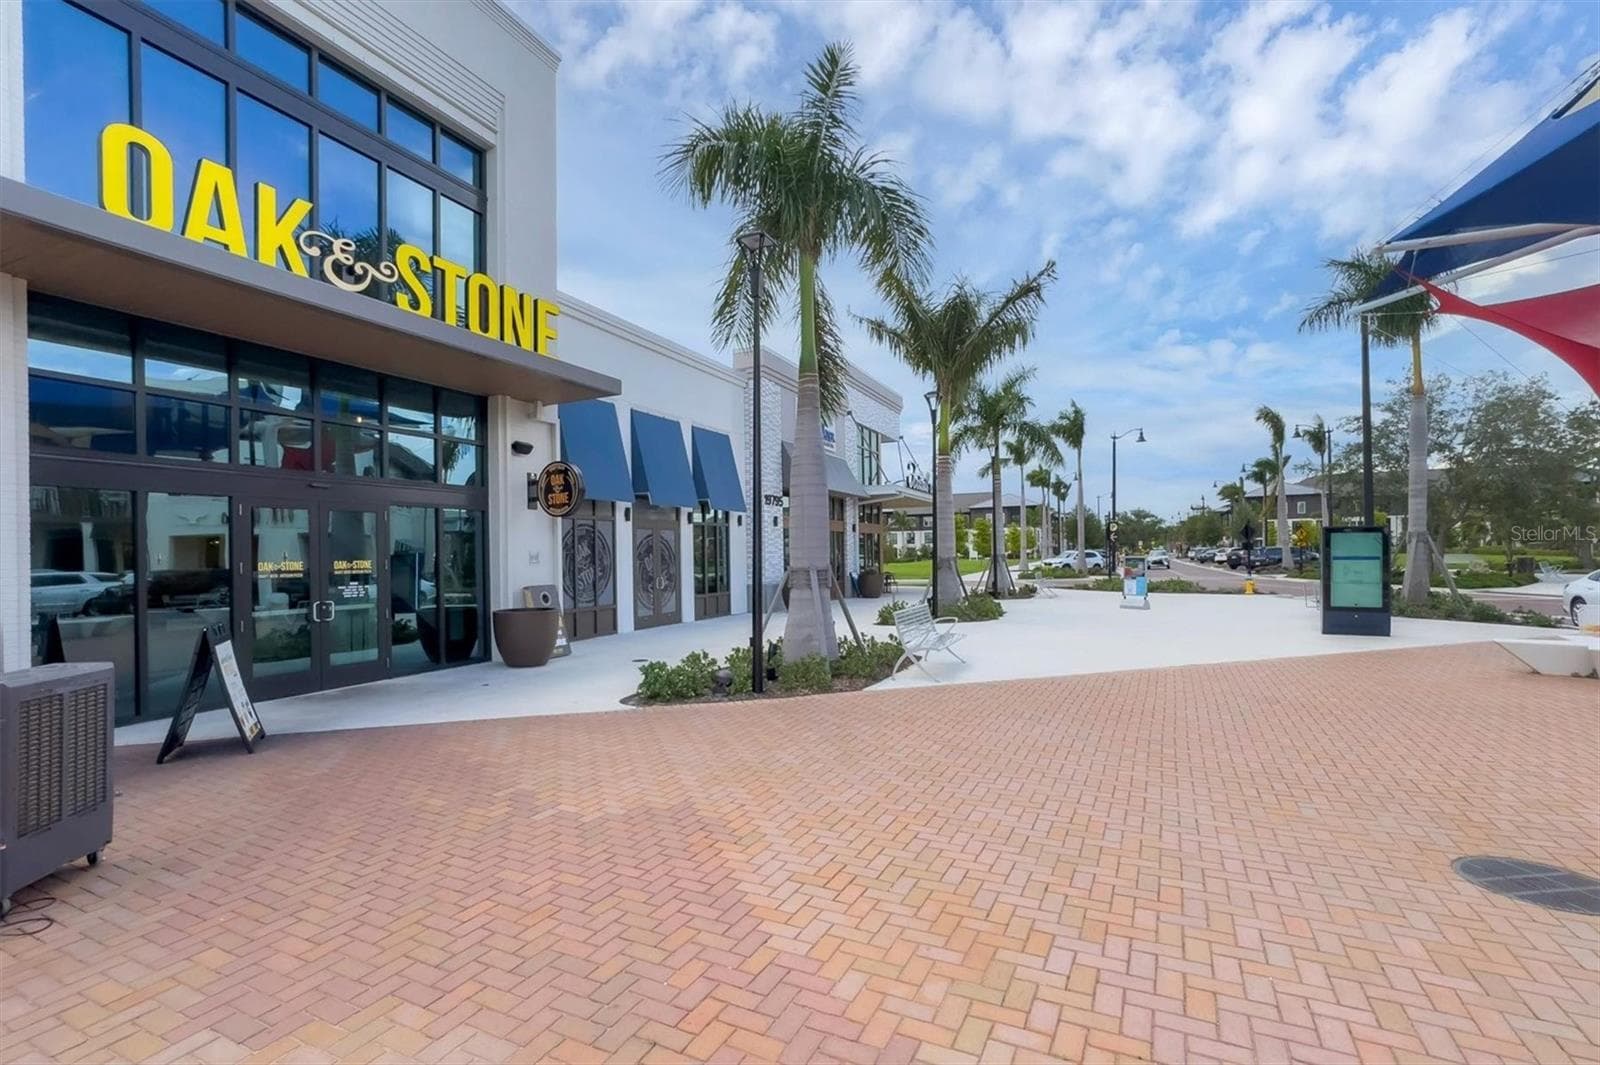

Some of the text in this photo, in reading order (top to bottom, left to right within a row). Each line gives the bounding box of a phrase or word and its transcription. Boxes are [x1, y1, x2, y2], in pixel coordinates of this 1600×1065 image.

[99, 122, 560, 356] OAK & STONE
[551, 474, 564, 486] OAK
[548, 491, 569, 505] STONE
[764, 494, 783, 507] 19795
[258, 562, 273, 571] OAK
[280, 560, 304, 571] STONE
[334, 560, 348, 570] OAK
[352, 559, 372, 569] STONE
